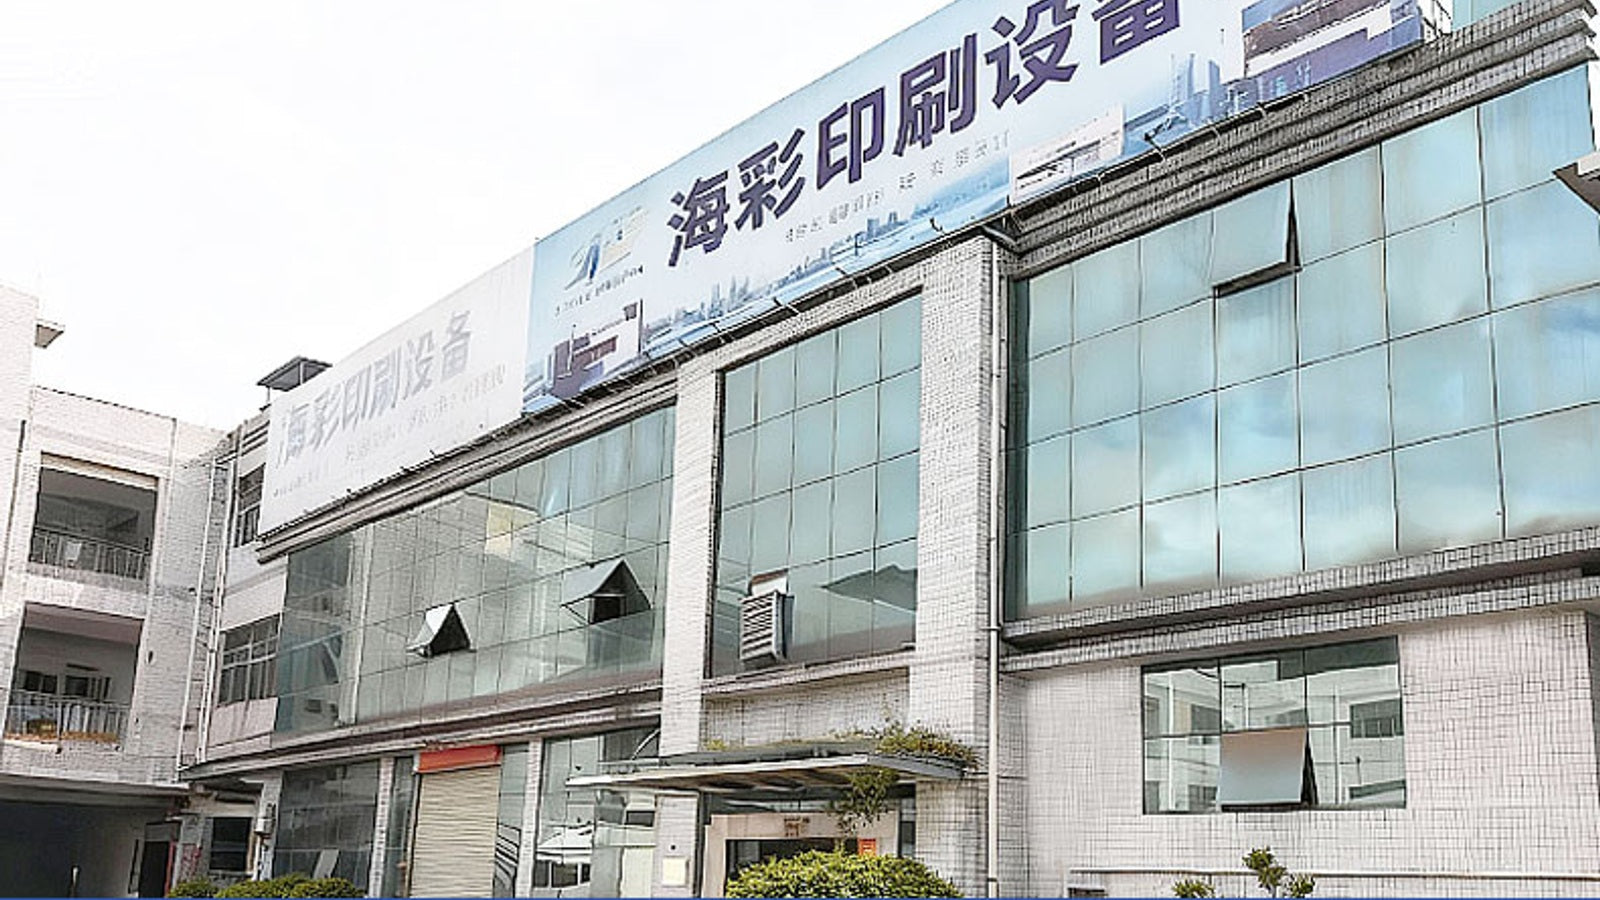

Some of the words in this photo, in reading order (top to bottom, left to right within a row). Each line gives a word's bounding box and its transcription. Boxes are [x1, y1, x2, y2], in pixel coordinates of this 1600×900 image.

[666, 0, 1181, 268] 海彩印刷设备
[273, 310, 472, 470] 海彩印刷设备
